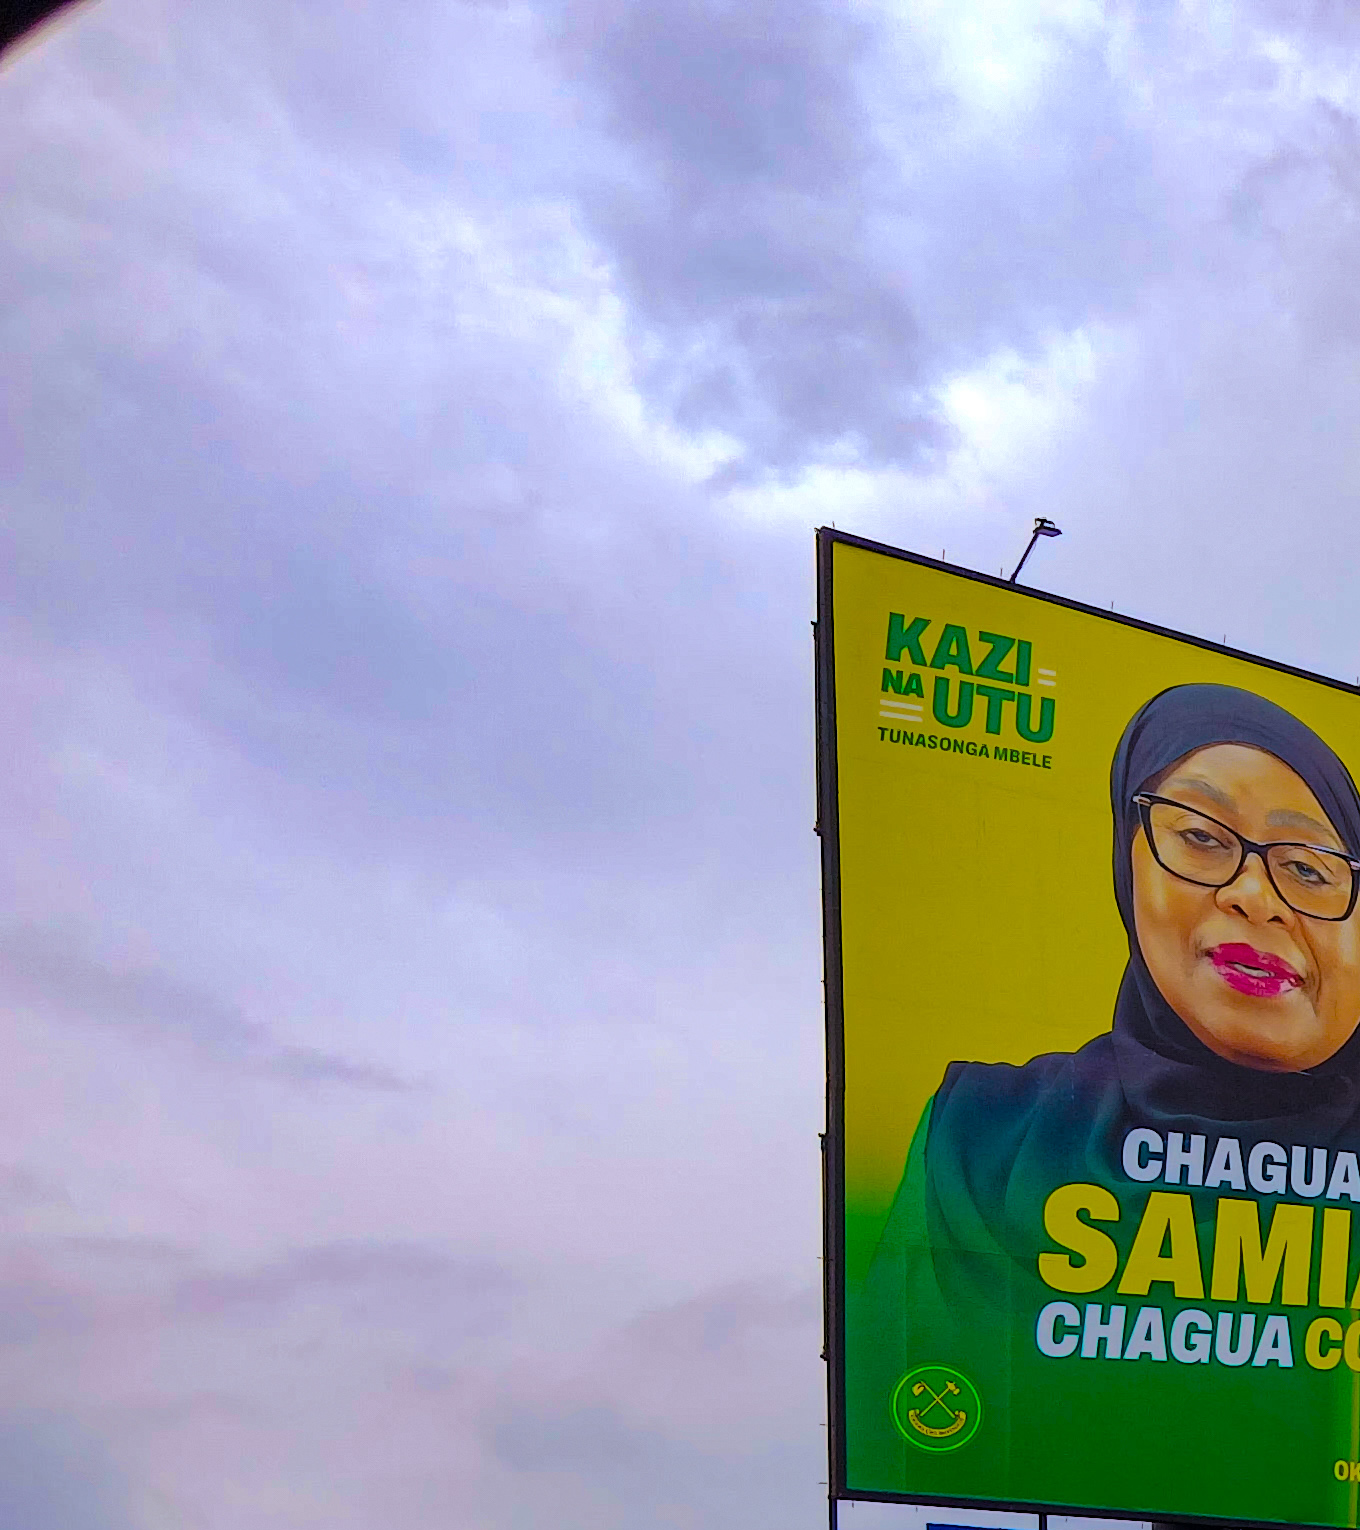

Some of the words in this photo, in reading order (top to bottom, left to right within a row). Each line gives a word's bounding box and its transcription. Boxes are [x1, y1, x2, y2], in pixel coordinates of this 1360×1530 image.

[885, 611, 1033, 687] KAZI
[880, 667, 925, 699] NA
[932, 675, 1056, 744] UTU
[877, 726, 990, 759] TUNASONGA
[993, 745, 1053, 770] MBELE
[1035, 1300, 1295, 1368] CHAGUA
